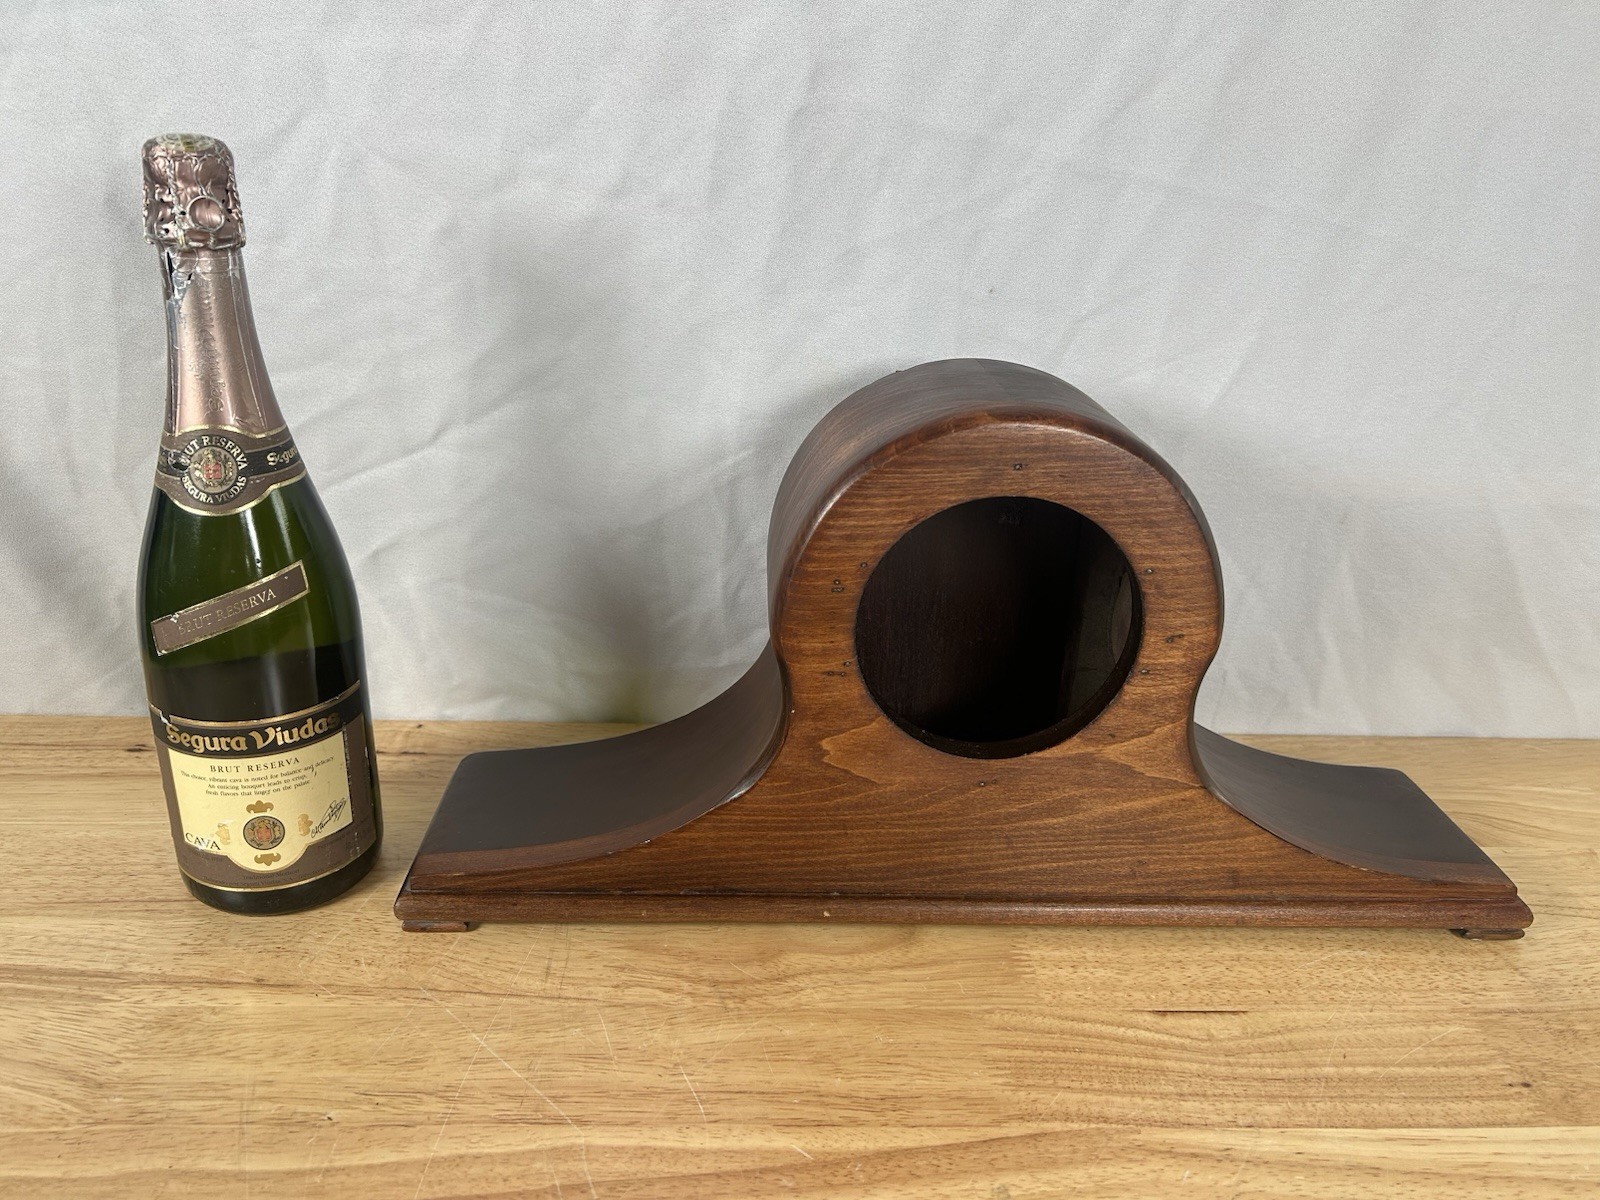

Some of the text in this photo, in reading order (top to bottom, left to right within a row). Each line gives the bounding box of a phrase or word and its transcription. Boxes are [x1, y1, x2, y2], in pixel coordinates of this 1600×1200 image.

[201, 435, 248, 470] RESERVA
[181, 474, 214, 503] SEGURA
[178, 588, 277, 636] BRUT RESERVA
[165, 712, 341, 754] Segura Viudas
[210, 757, 300, 773] BRUT RESERVA
[280, 768, 302, 777] balance
[185, 832, 221, 851] CAVA
